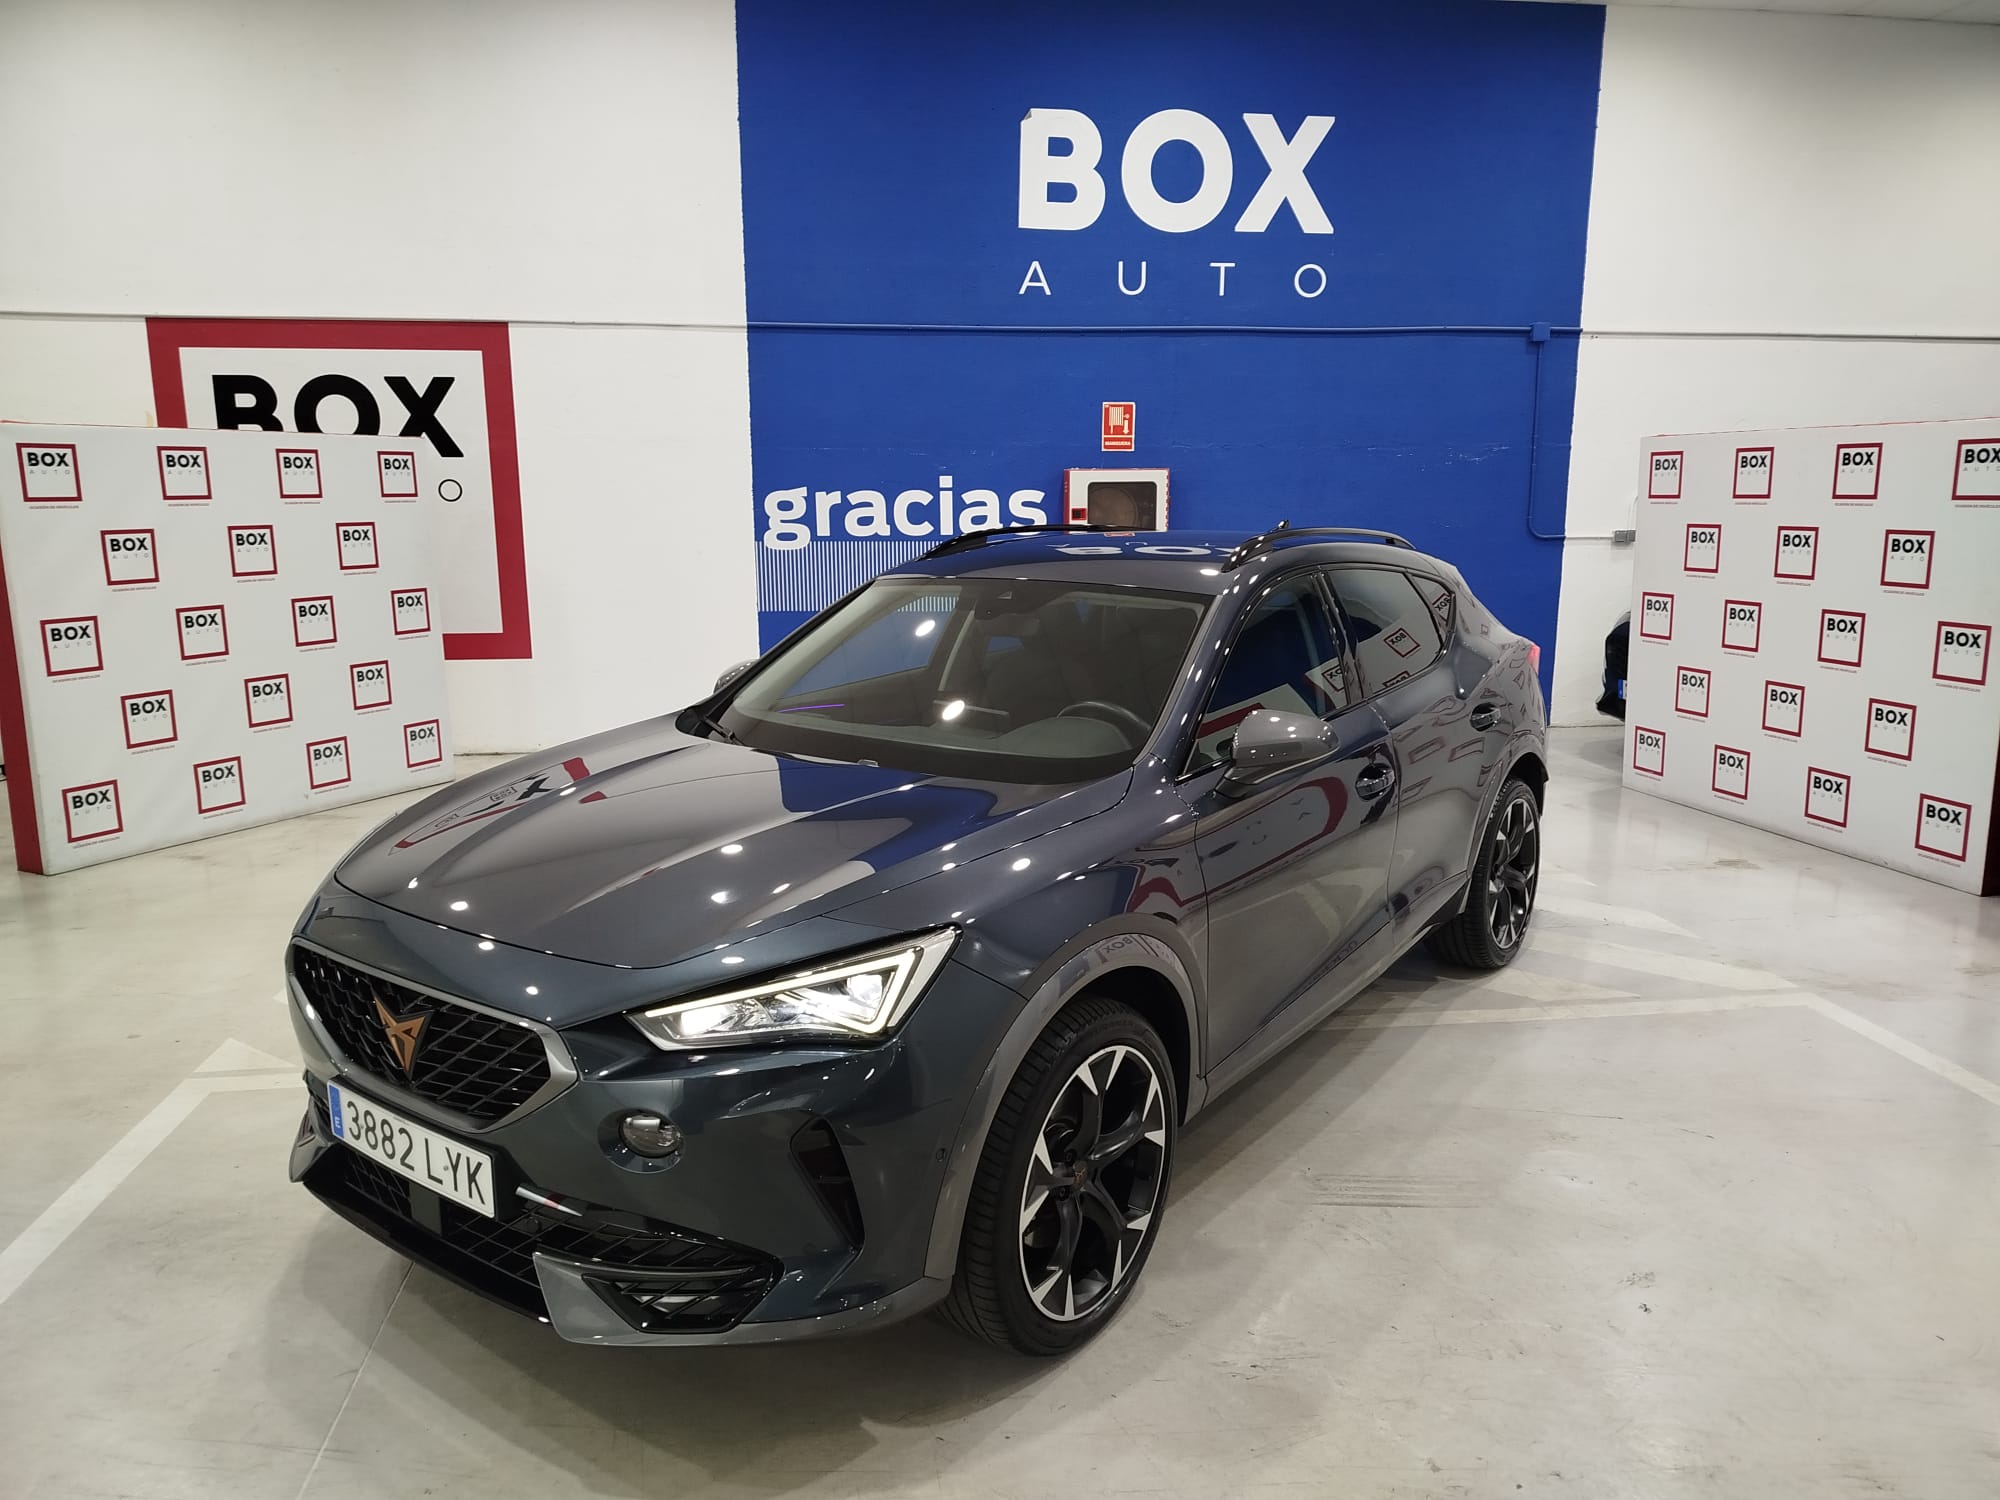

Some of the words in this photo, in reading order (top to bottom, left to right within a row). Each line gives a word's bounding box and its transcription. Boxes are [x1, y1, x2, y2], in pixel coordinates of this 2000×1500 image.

[1018, 108, 1336, 234] BOX
[1018, 261, 1327, 298] AUTO
[28, 452, 69, 466] BOX
[166, 455, 200, 467] BOX
[284, 457, 313, 468] BOX
[1741, 456, 1767, 468] BOX
[1842, 452, 1874, 465] BOX
[1964, 448, 2000, 463] BOX
[384, 458, 410, 470] BOX
[1655, 459, 1677, 470] BOX
[764, 476, 1047, 550] gracias
[236, 533, 267, 546] BOX
[343, 530, 370, 541] BOX
[1692, 532, 1715, 543] BOX
[1783, 535, 1811, 547] BOX
[110, 538, 147, 552] BOX
[1892, 539, 1925, 553] BOX
[398, 595, 422, 608] BOX
[1646, 600, 1668, 612] BOX
[299, 604, 327, 617] BOX
[1730, 608, 1755, 621] BOX
[185, 614, 218, 628] BOX
[1827, 618, 1857, 633] BOX
[51, 625, 90, 641] BOX
[1944, 631, 1981, 648] BOX
[357, 668, 383, 682] BOX
[1682, 674, 1704, 688] BOX
[252, 682, 283, 697] BOX
[1771, 689, 1797, 705] BOX
[130, 699, 166, 715] BOX
[1875, 708, 1907, 726] BOX
[410, 727, 434, 741] BOX
[1640, 734, 1660, 748] BOX
[314, 745, 342, 760] BOX
[1720, 753, 1744, 769] BOX
[202, 765, 235, 782] BOX
[1814, 776, 1843, 794] BOX
[72, 790, 110, 809] BOX
[1926, 804, 1962, 825] BOX
[347, 1100, 415, 1171] 3882
[424, 1137, 486, 1205] LYK
